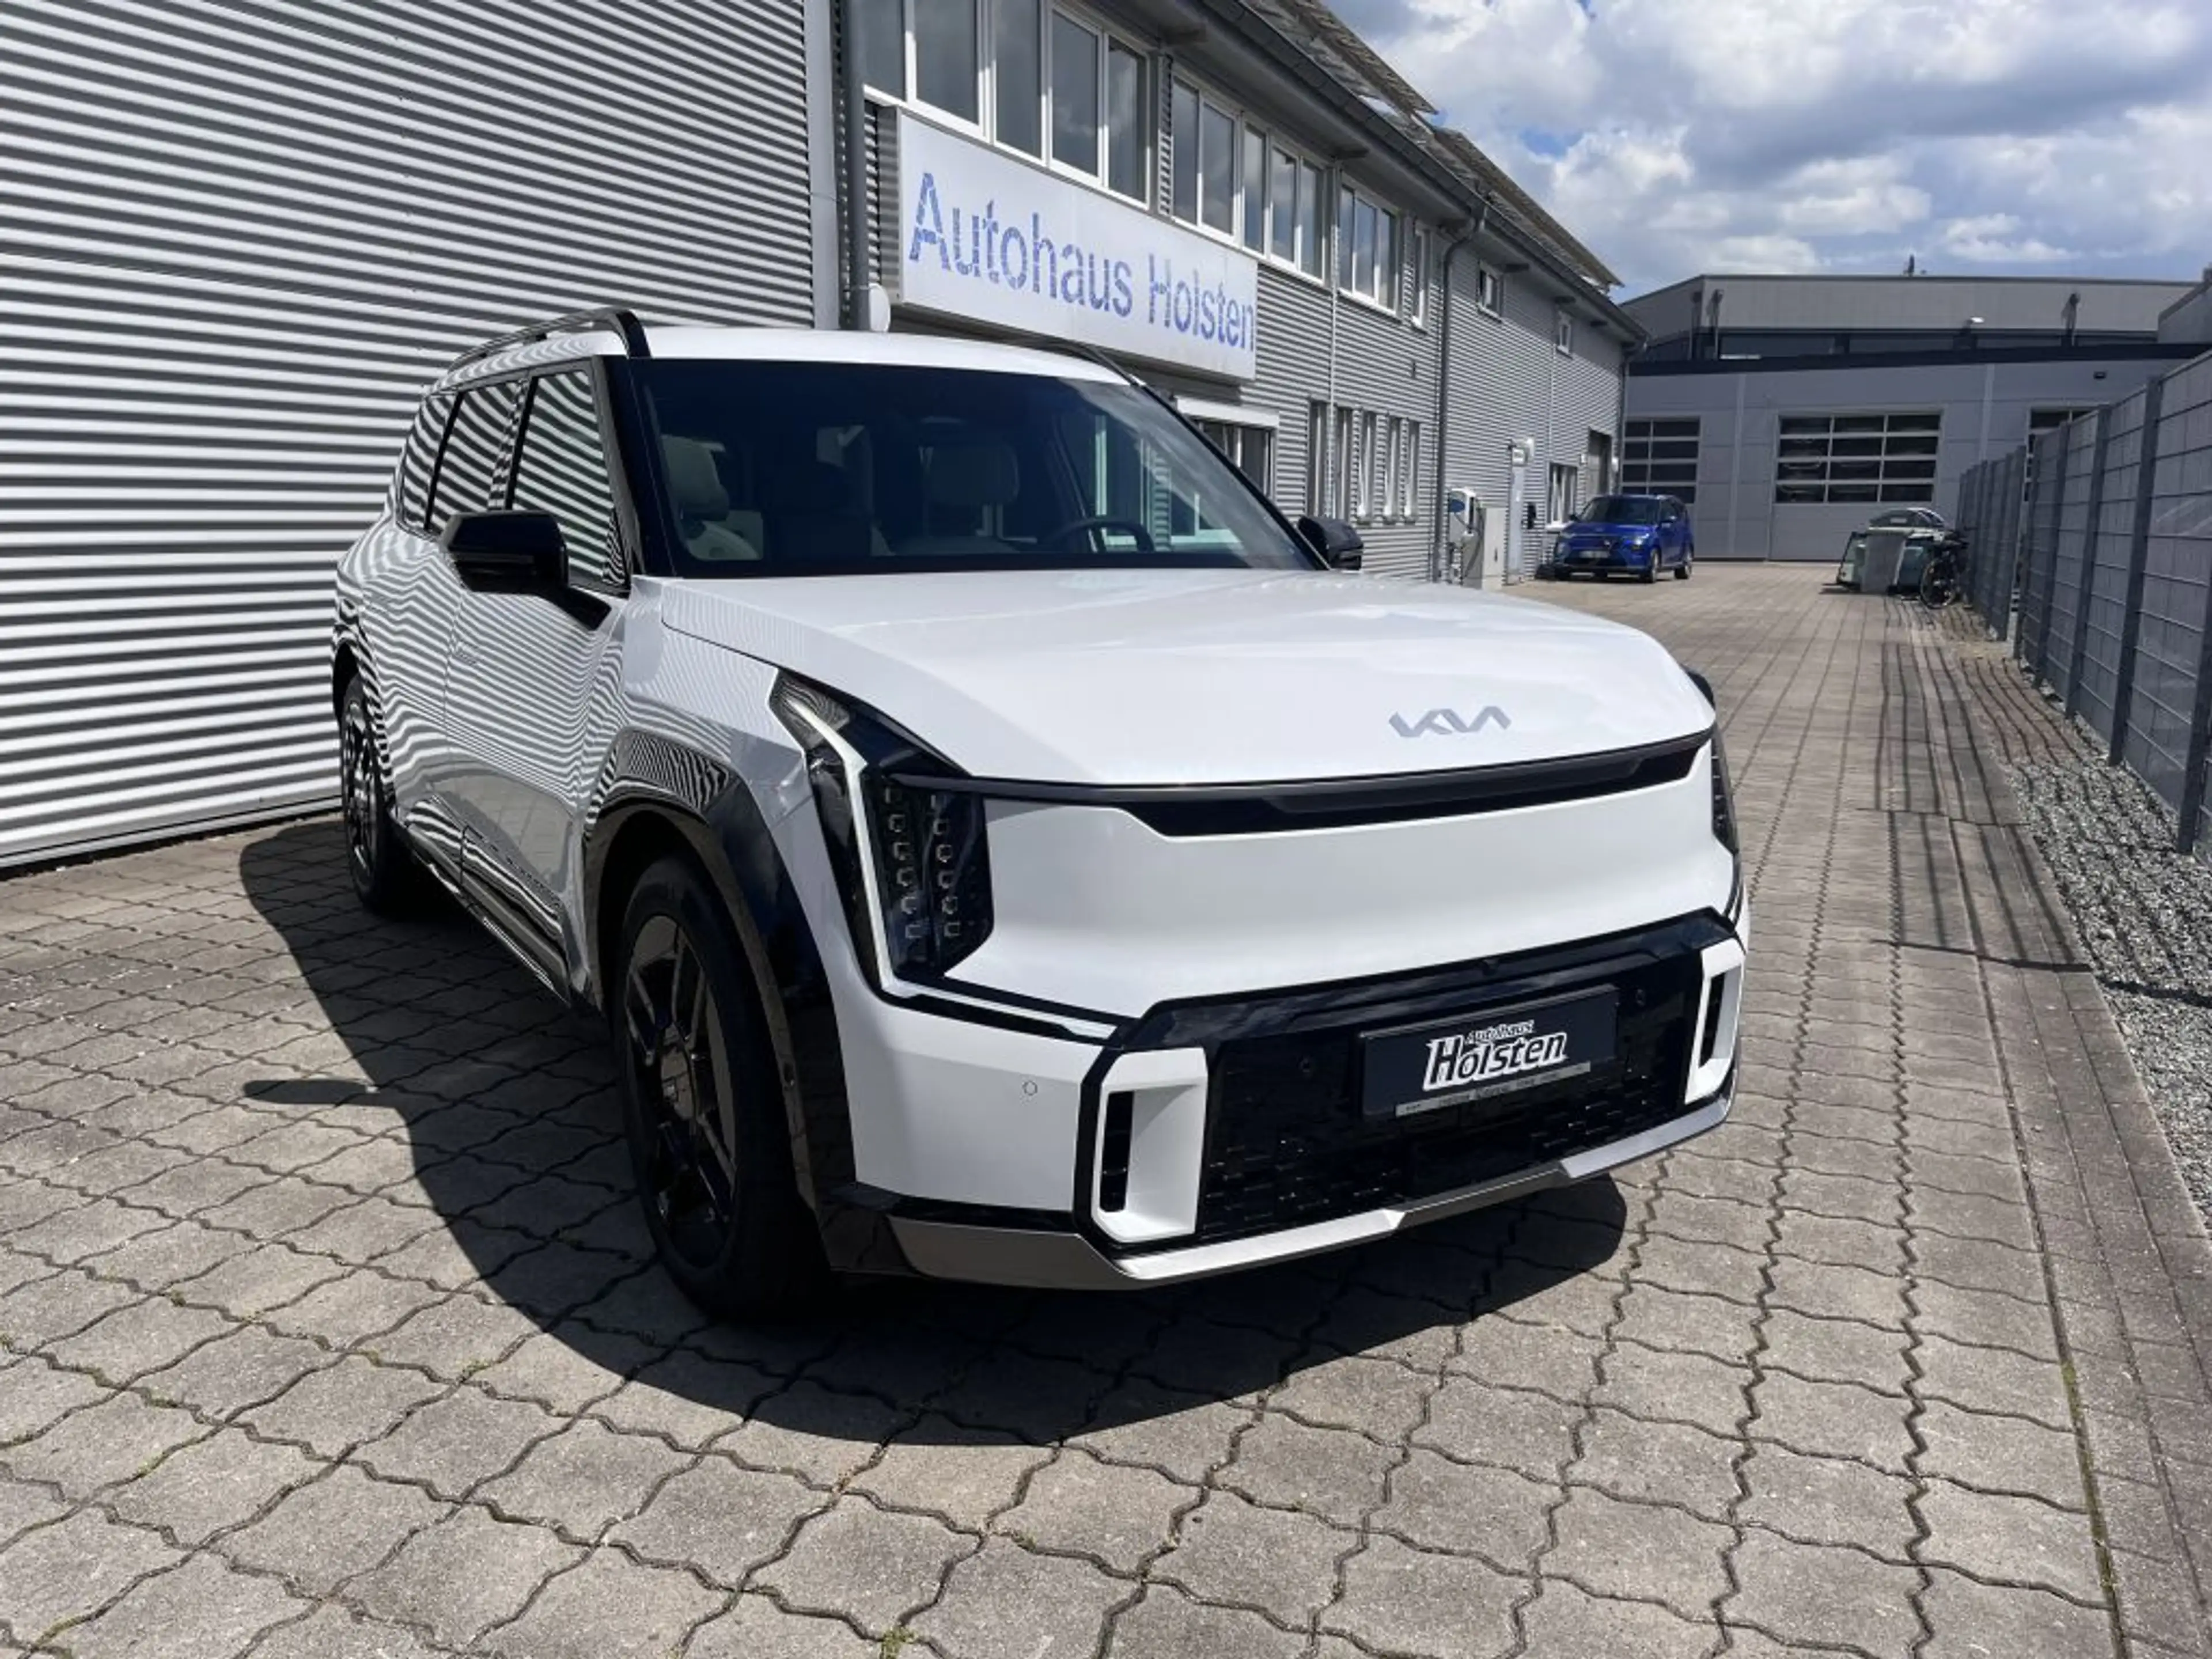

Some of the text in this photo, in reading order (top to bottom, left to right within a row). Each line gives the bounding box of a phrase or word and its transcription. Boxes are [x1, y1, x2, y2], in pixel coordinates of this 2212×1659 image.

[908, 172, 1255, 351] Autohaus Holsten
[1424, 1033, 1568, 1090] Holsten
